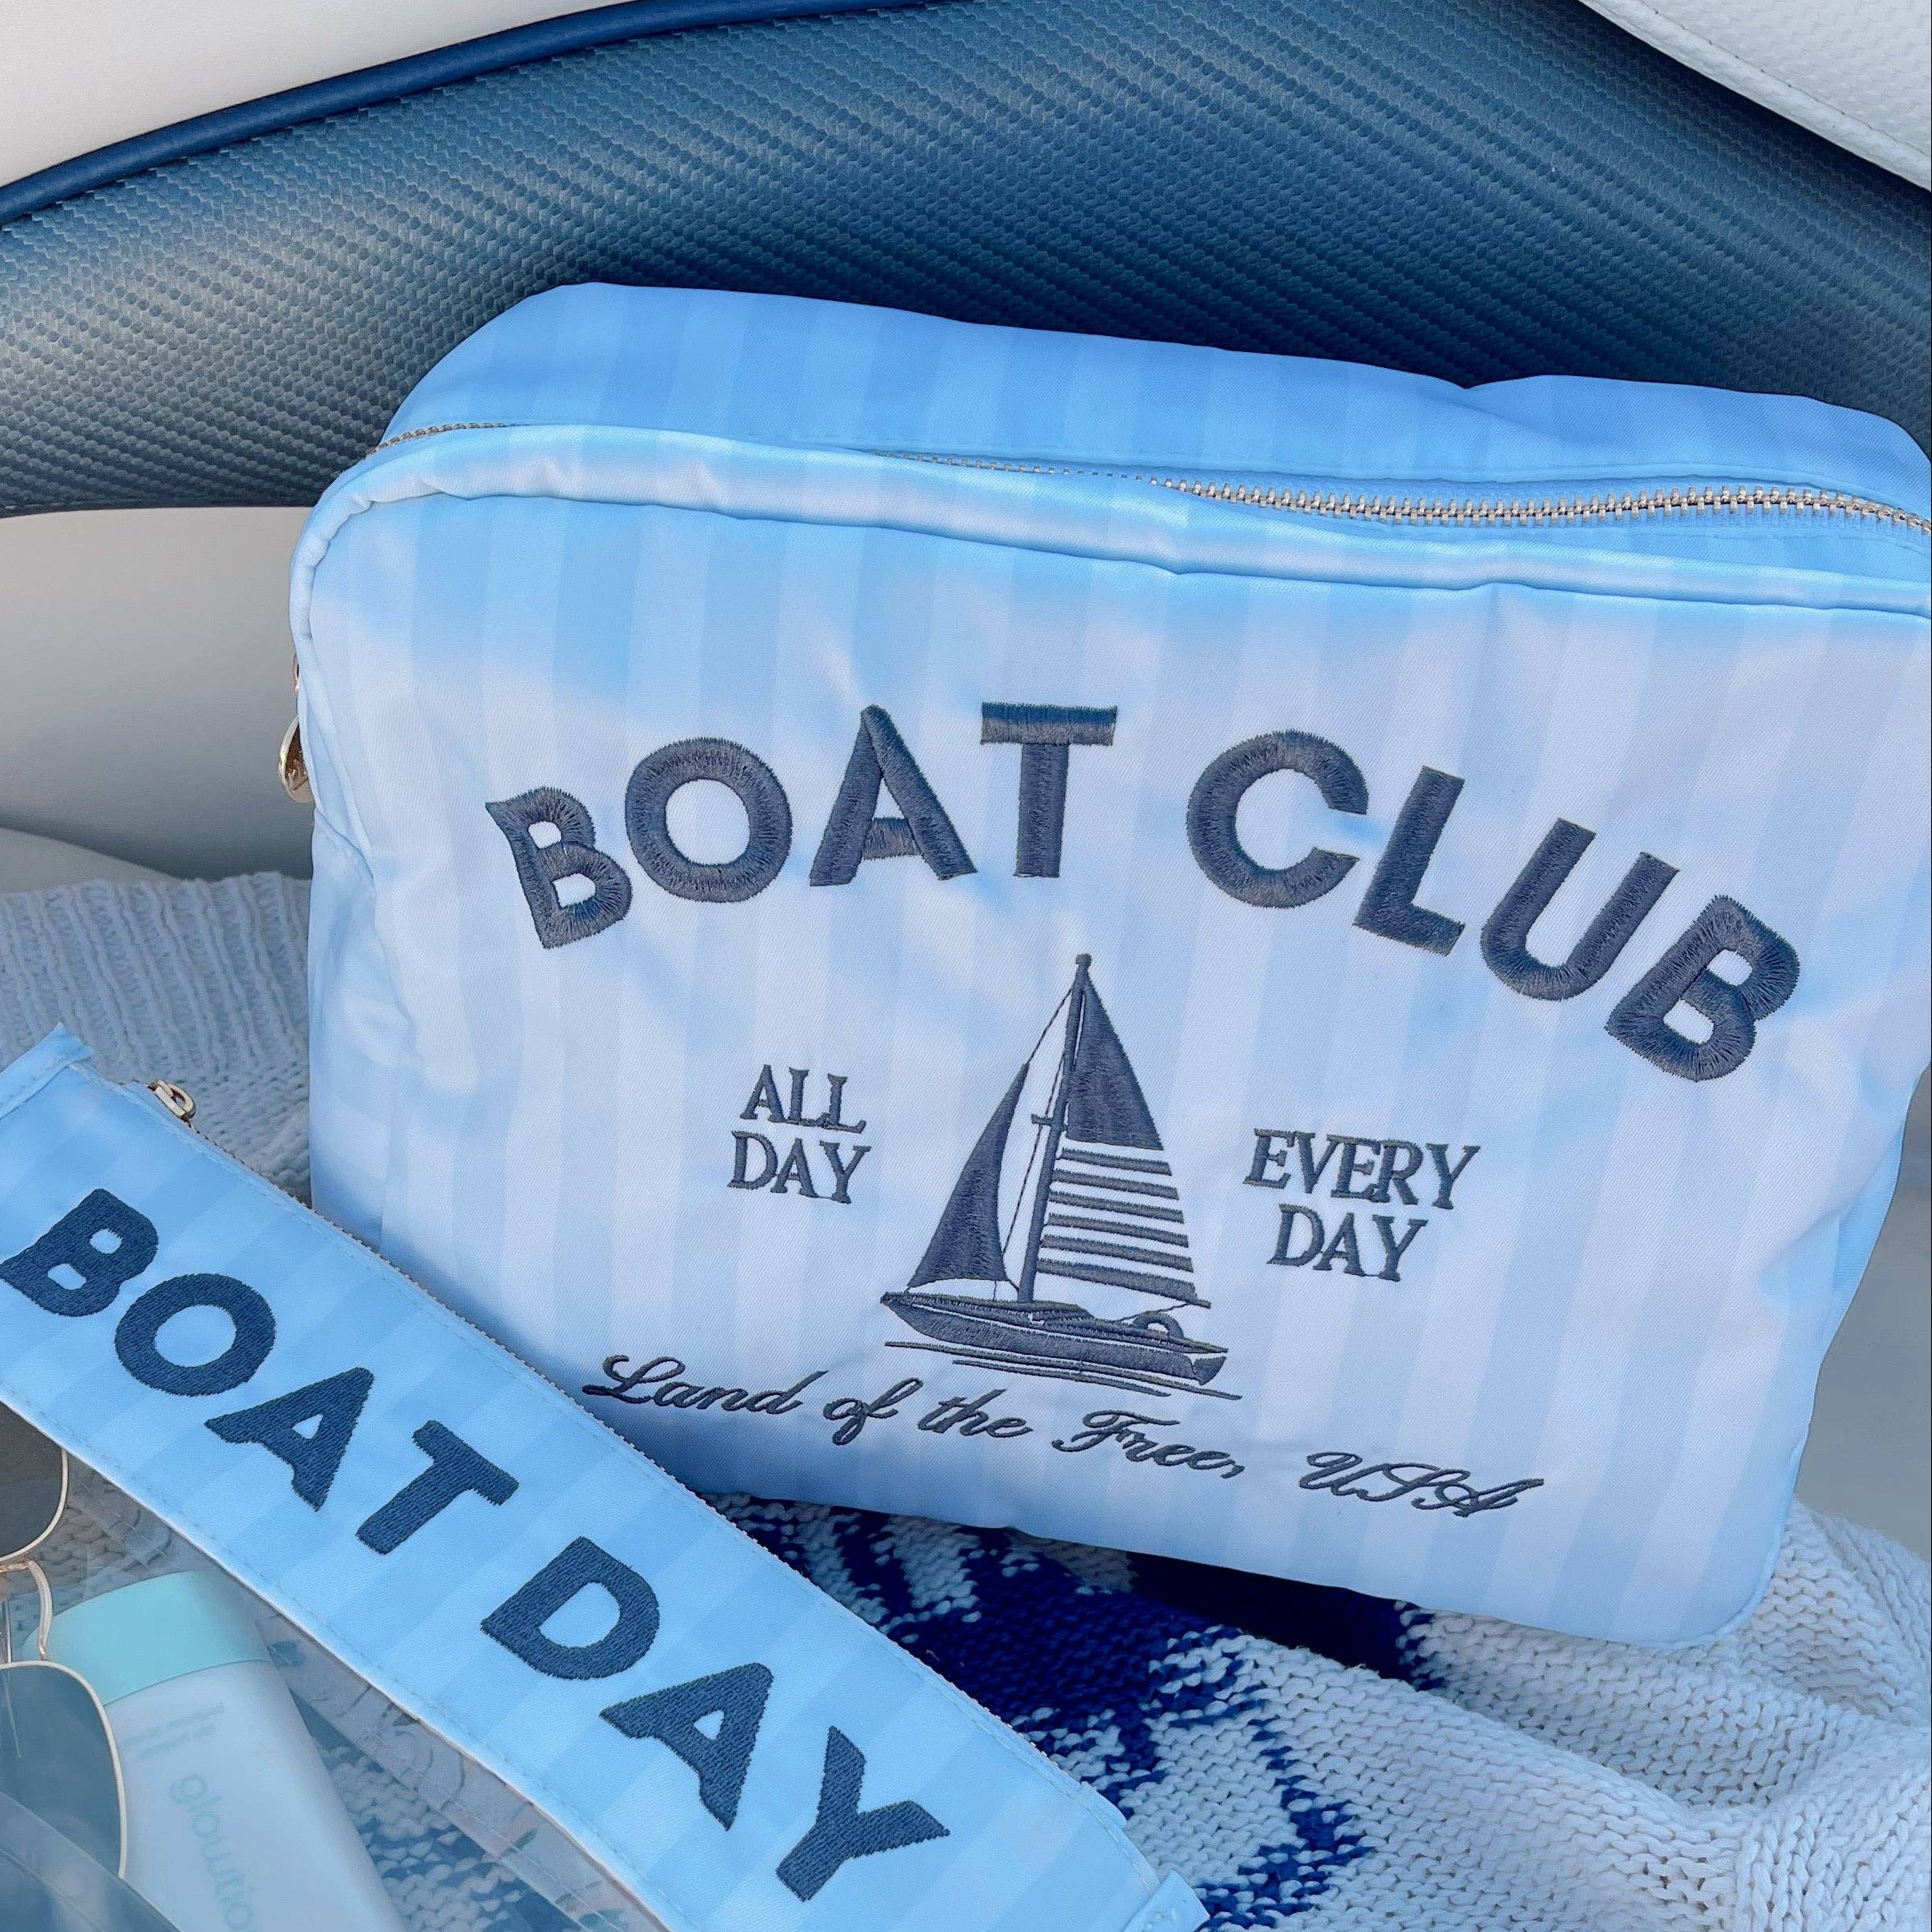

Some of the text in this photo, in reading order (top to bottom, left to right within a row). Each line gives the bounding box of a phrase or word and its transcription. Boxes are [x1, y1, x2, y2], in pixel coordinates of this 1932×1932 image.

[485, 702, 1800, 1083] BOAT CLUB
[739, 1064, 867, 1134] ALL
[727, 1130, 871, 1204] DAY
[1242, 1128, 1481, 1209] EVERY
[1266, 1203, 1428, 1282] DAY
[582, 1355, 828, 1415] Land
[823, 1377, 924, 1446] of
[917, 1389, 1033, 1438] the
[1299, 1452, 1544, 1518] USA
[0, 1188, 950, 1902] BOAT DAY
